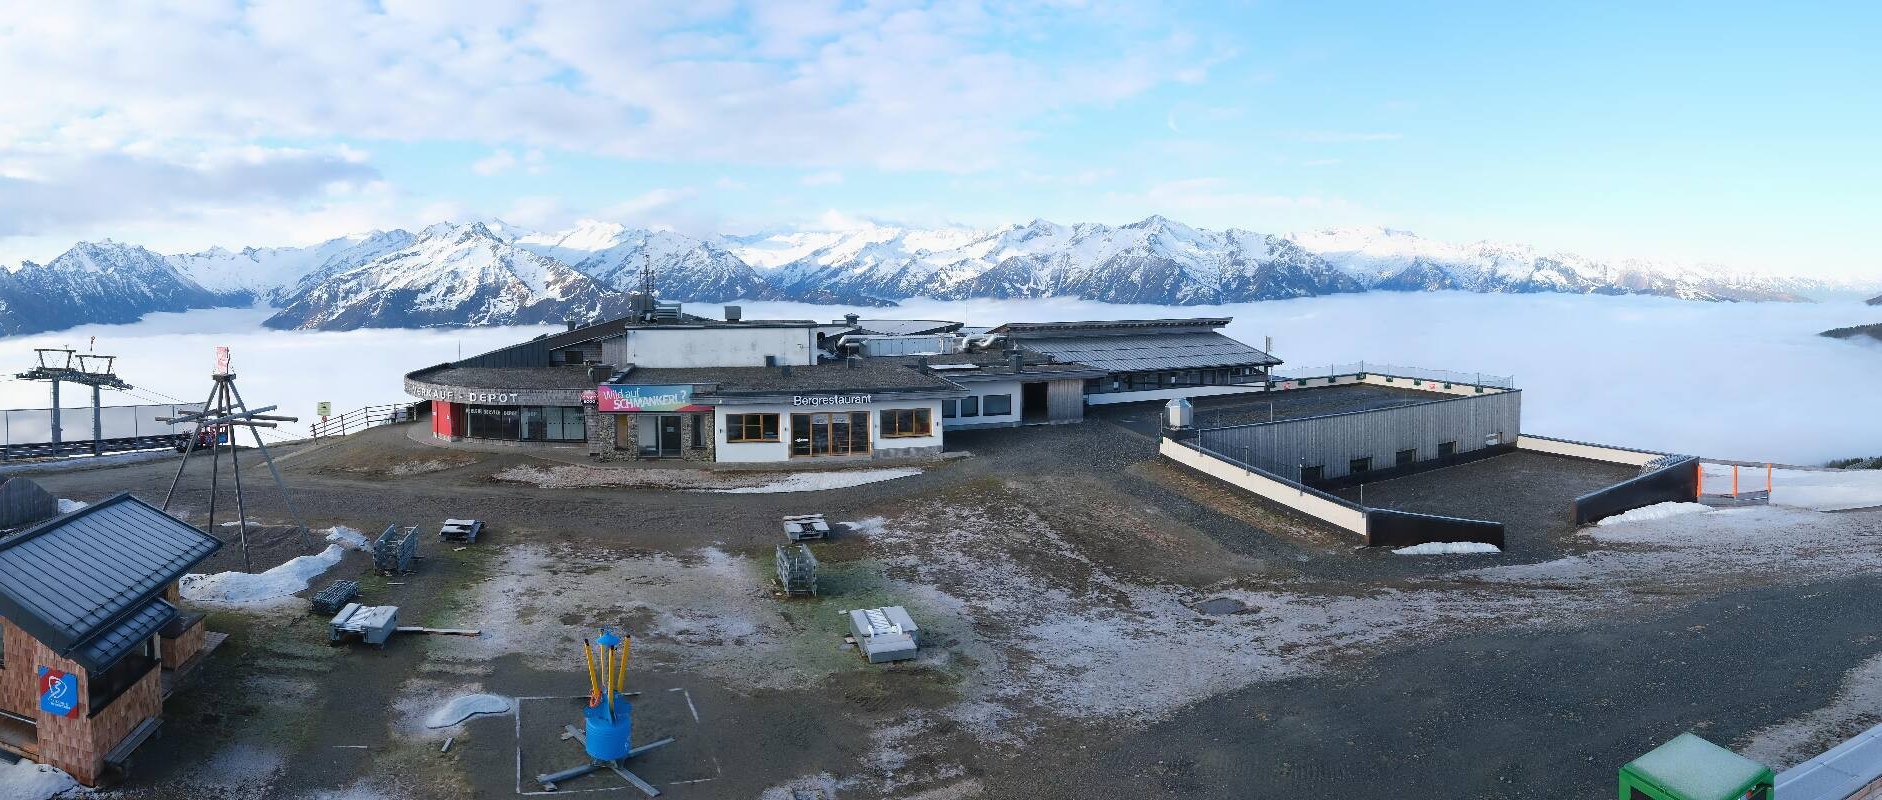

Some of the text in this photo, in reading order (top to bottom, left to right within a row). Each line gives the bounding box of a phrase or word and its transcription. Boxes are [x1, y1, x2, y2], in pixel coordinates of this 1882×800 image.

[412, 385, 454, 400] VERKAUF
[469, 392, 519, 403] DEPOT
[603, 388, 641, 400] Wild auf
[613, 390, 687, 410] SCHMANKERL?
[794, 394, 872, 407] Bergrestaurant
